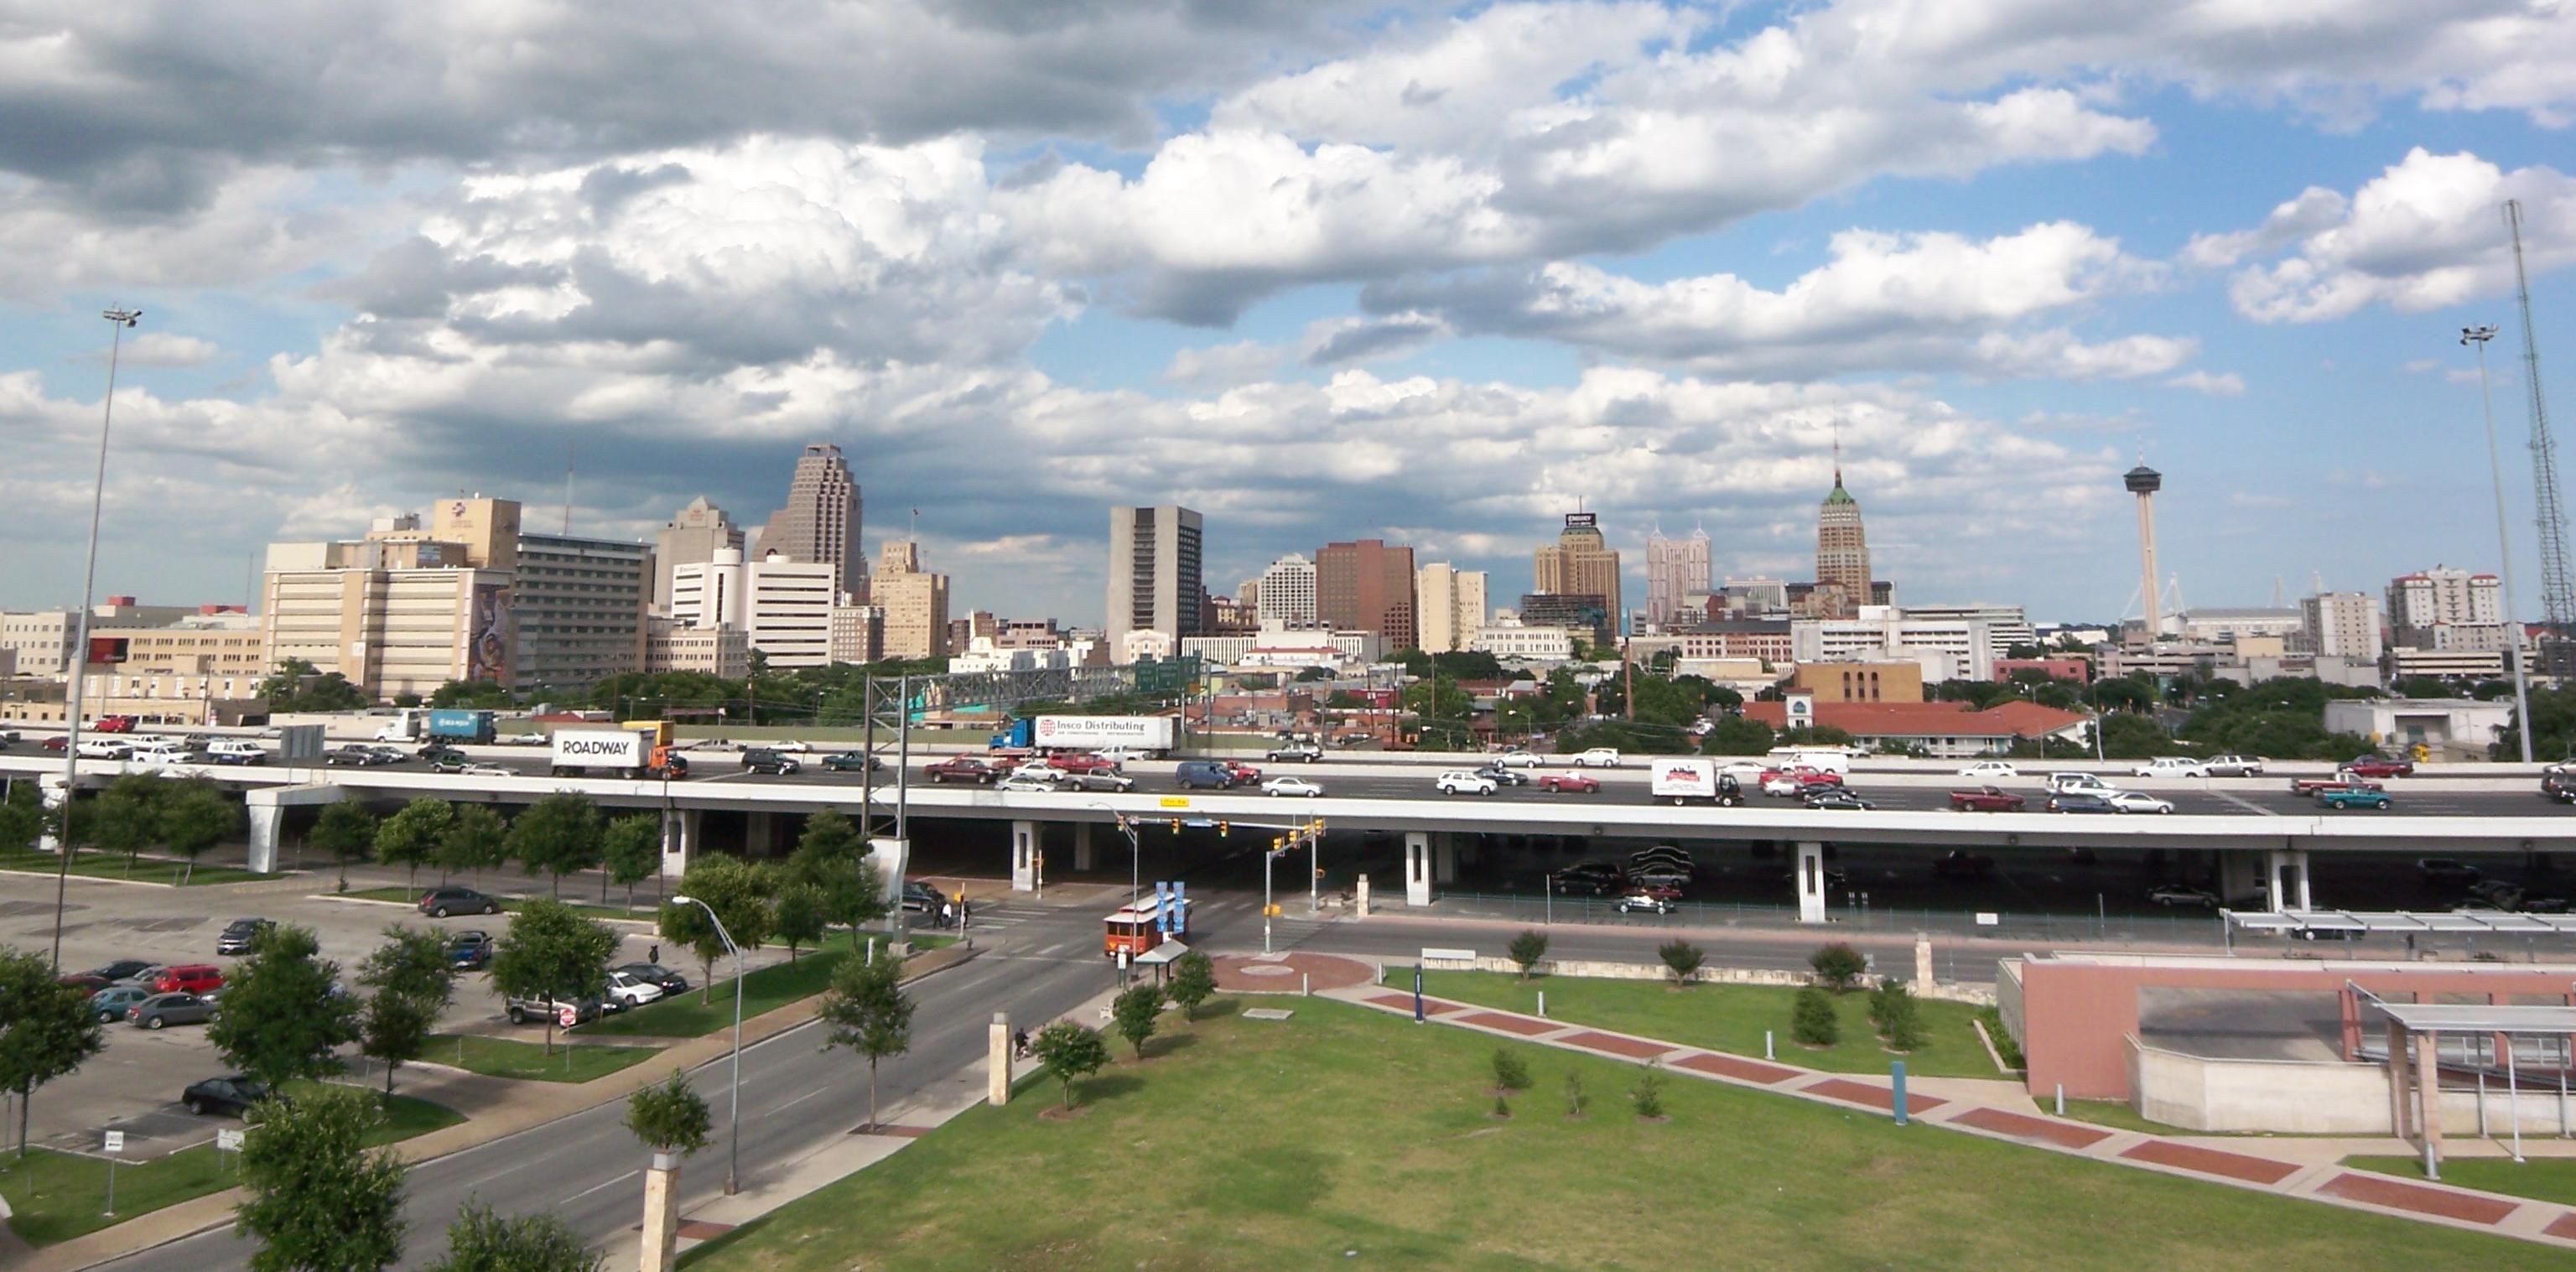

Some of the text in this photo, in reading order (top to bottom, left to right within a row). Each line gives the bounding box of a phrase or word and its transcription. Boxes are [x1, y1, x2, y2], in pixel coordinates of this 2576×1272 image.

[1057, 720, 1145, 731] Insco Distributing
[563, 740, 630, 755] ROADWAY
